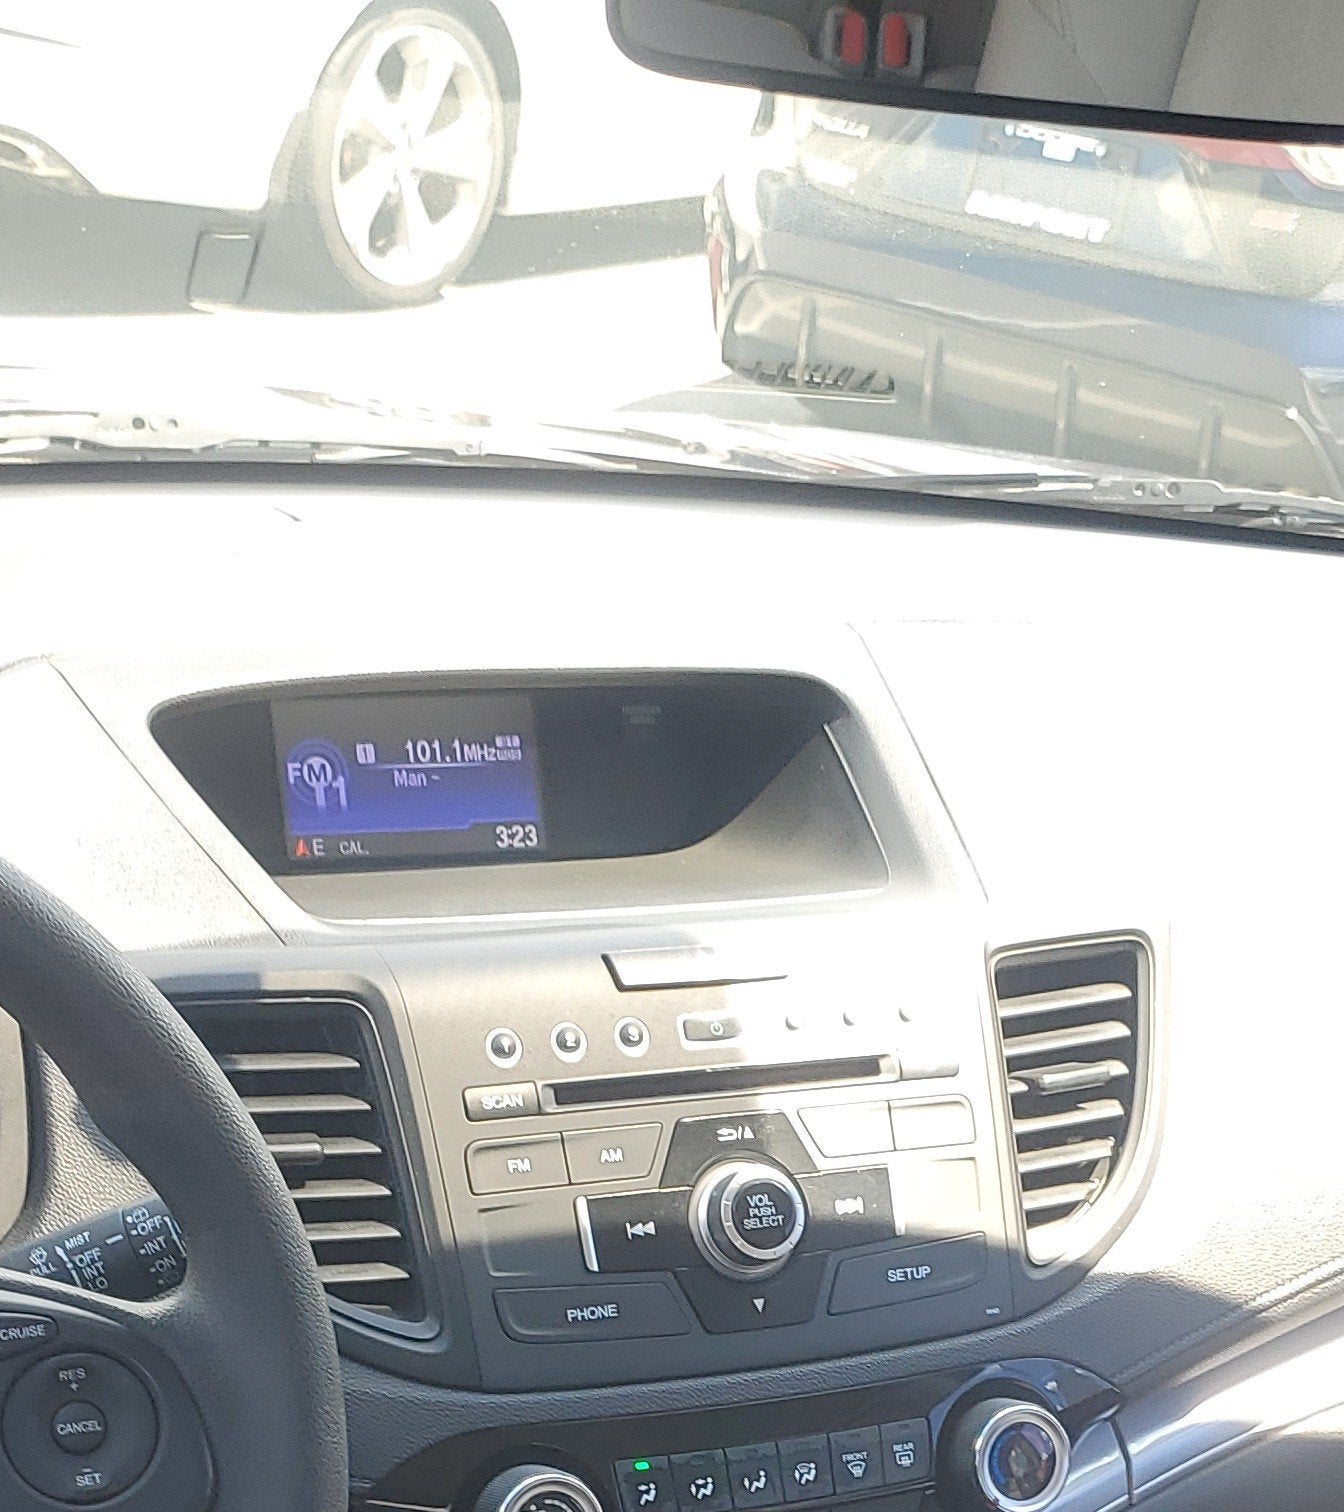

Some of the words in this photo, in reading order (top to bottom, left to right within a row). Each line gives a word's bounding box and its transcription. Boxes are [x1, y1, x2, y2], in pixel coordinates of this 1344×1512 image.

[495, 824, 538, 849] 3:23
[480, 1093, 524, 1110] SCAN
[600, 1147, 624, 1164] AM
[507, 1157, 532, 1174] FM
[746, 1193, 774, 1207] VOL
[748, 1205, 777, 1218] PUSH
[137, 1214, 164, 1236] OFF
[742, 1214, 785, 1231] SELECT
[64, 1230, 91, 1251] MIST
[144, 1235, 169, 1256] INT
[74, 1246, 102, 1268] OFF
[156, 1253, 178, 1273] ON
[82, 1261, 106, 1280] INT
[886, 1263, 932, 1285] SETUP
[87, 1276, 109, 1291] LO
[566, 1302, 619, 1324] PHONE
[58, 1366, 87, 1382] RES
[56, 1419, 103, 1436] CANCEL
[841, 1450, 869, 1463] FRONT
[75, 1472, 102, 1487] SET
